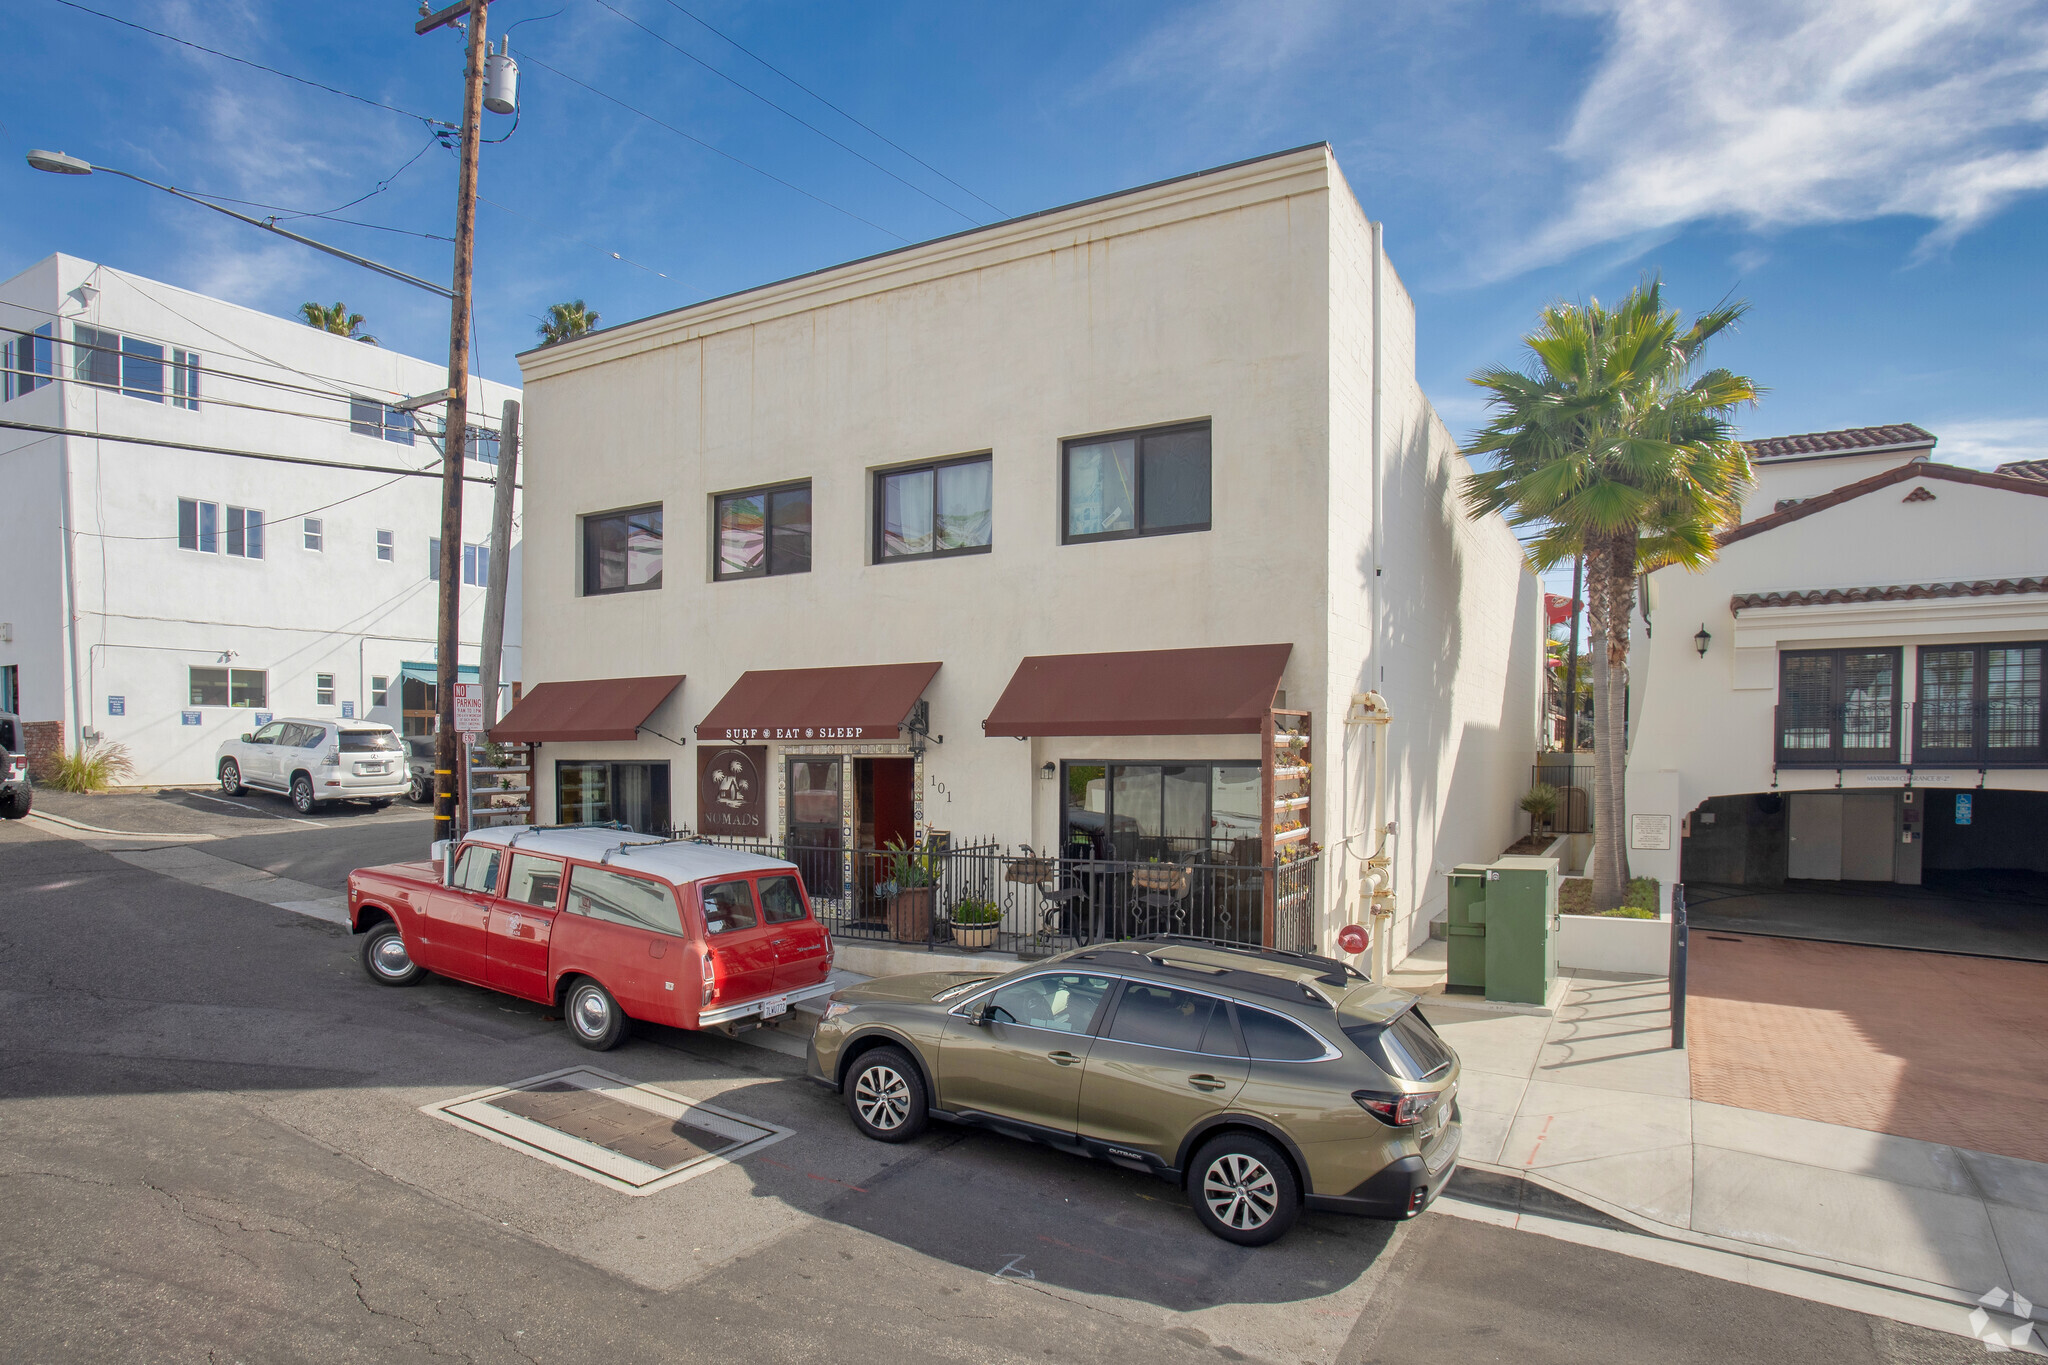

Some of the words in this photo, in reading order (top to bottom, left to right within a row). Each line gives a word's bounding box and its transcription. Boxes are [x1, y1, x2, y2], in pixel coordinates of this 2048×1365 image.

[455, 685, 465, 697] NO
[457, 699, 482, 708] PARKING
[464, 734, 475, 742] END
[725, 728, 758, 739] SURF
[776, 728, 800, 739] EAT
[819, 727, 863, 738] SLEEP
[931, 774, 952, 803] 101
[705, 812, 759, 826] NOMADS
[1108, 1147, 1142, 1160] OUTBACK
